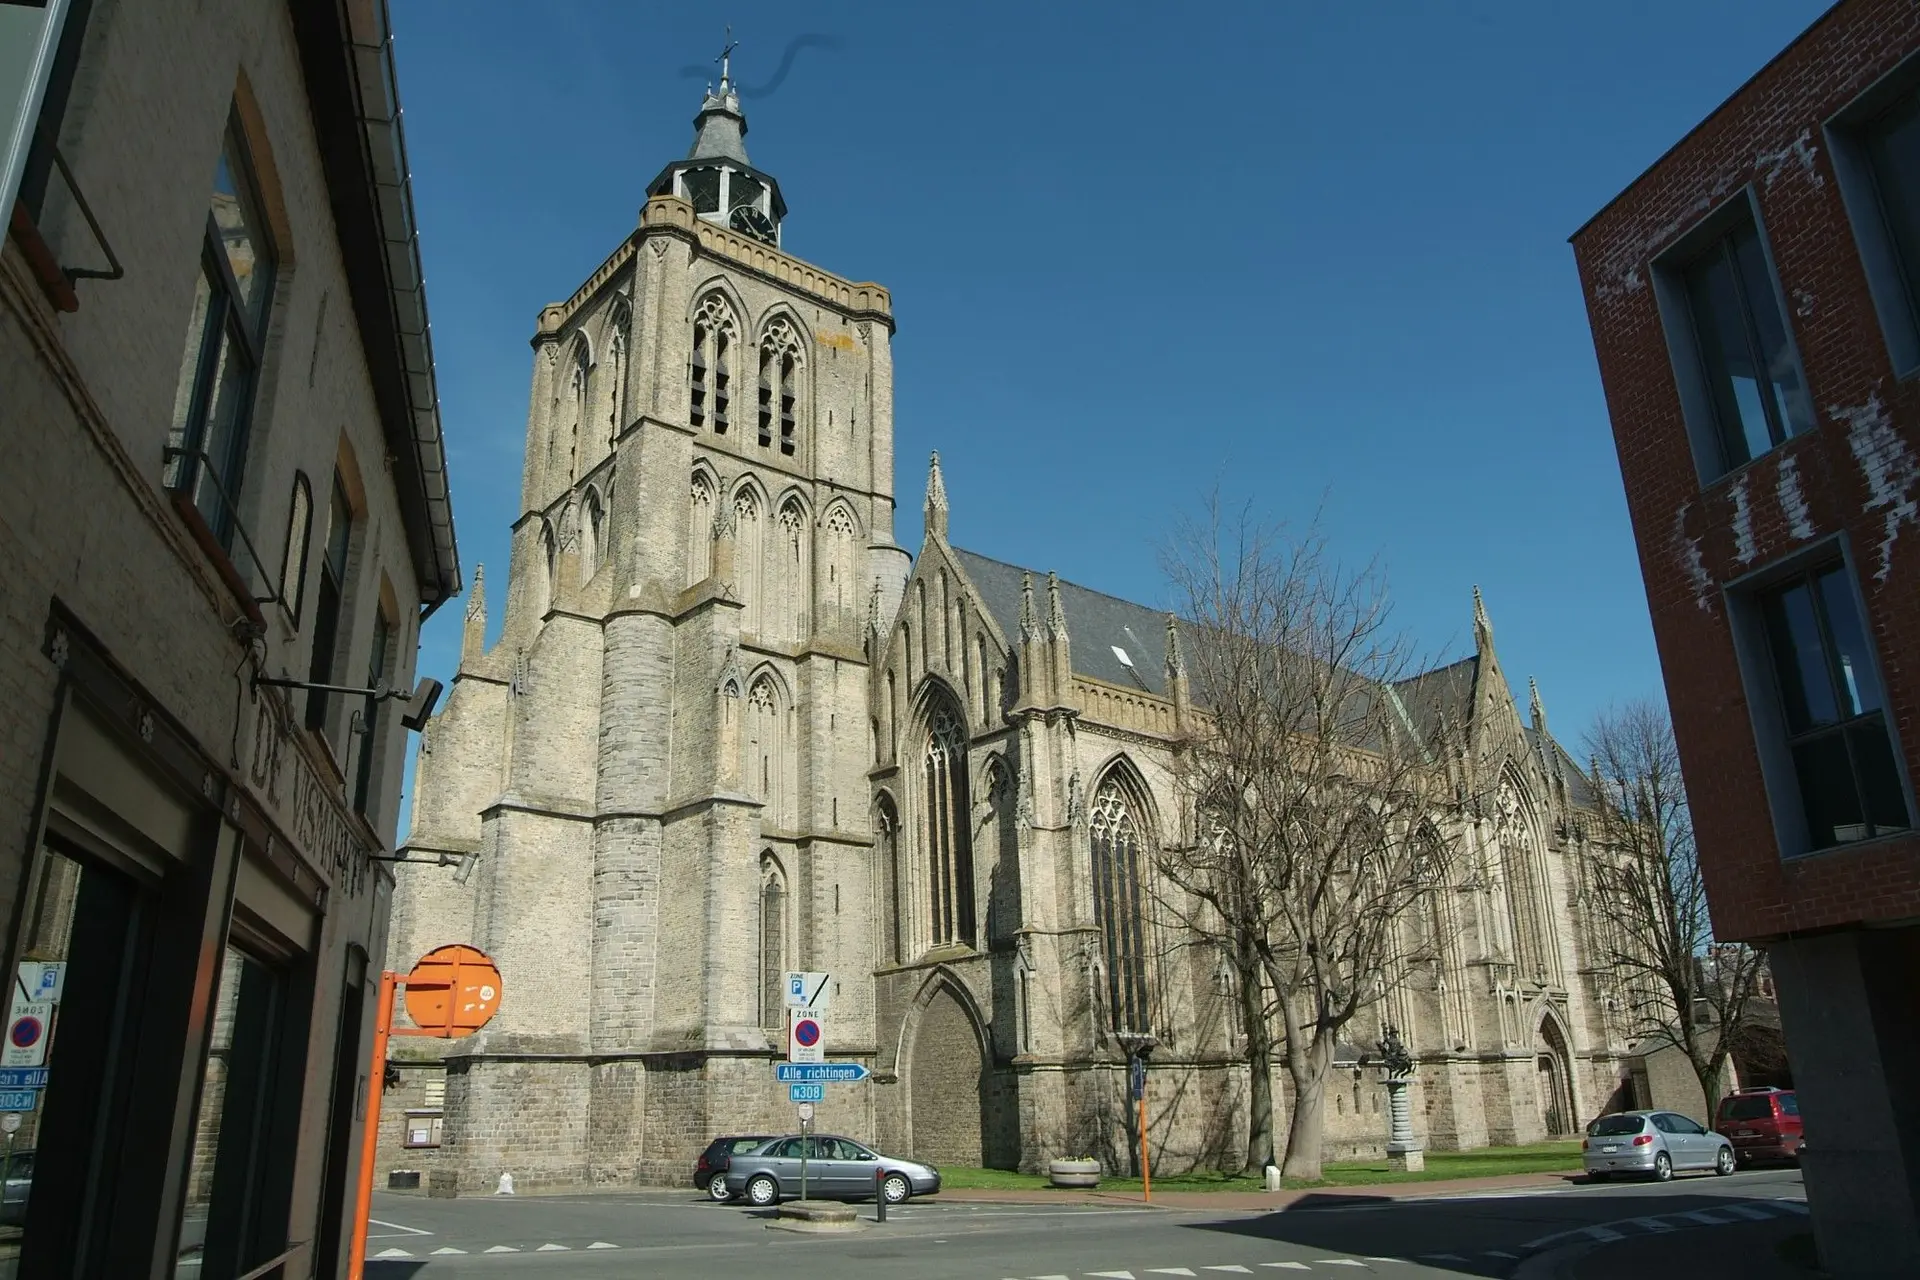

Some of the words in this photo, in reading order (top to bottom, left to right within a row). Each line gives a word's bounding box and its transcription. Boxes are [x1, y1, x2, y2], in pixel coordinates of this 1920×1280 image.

[252, 703, 282, 812] DE
[796, 1010, 819, 1018] ZONE
[782, 1066, 802, 1079] Alle
[806, 1066, 856, 1081] richtingen
[793, 1086, 820, 1099] N308
